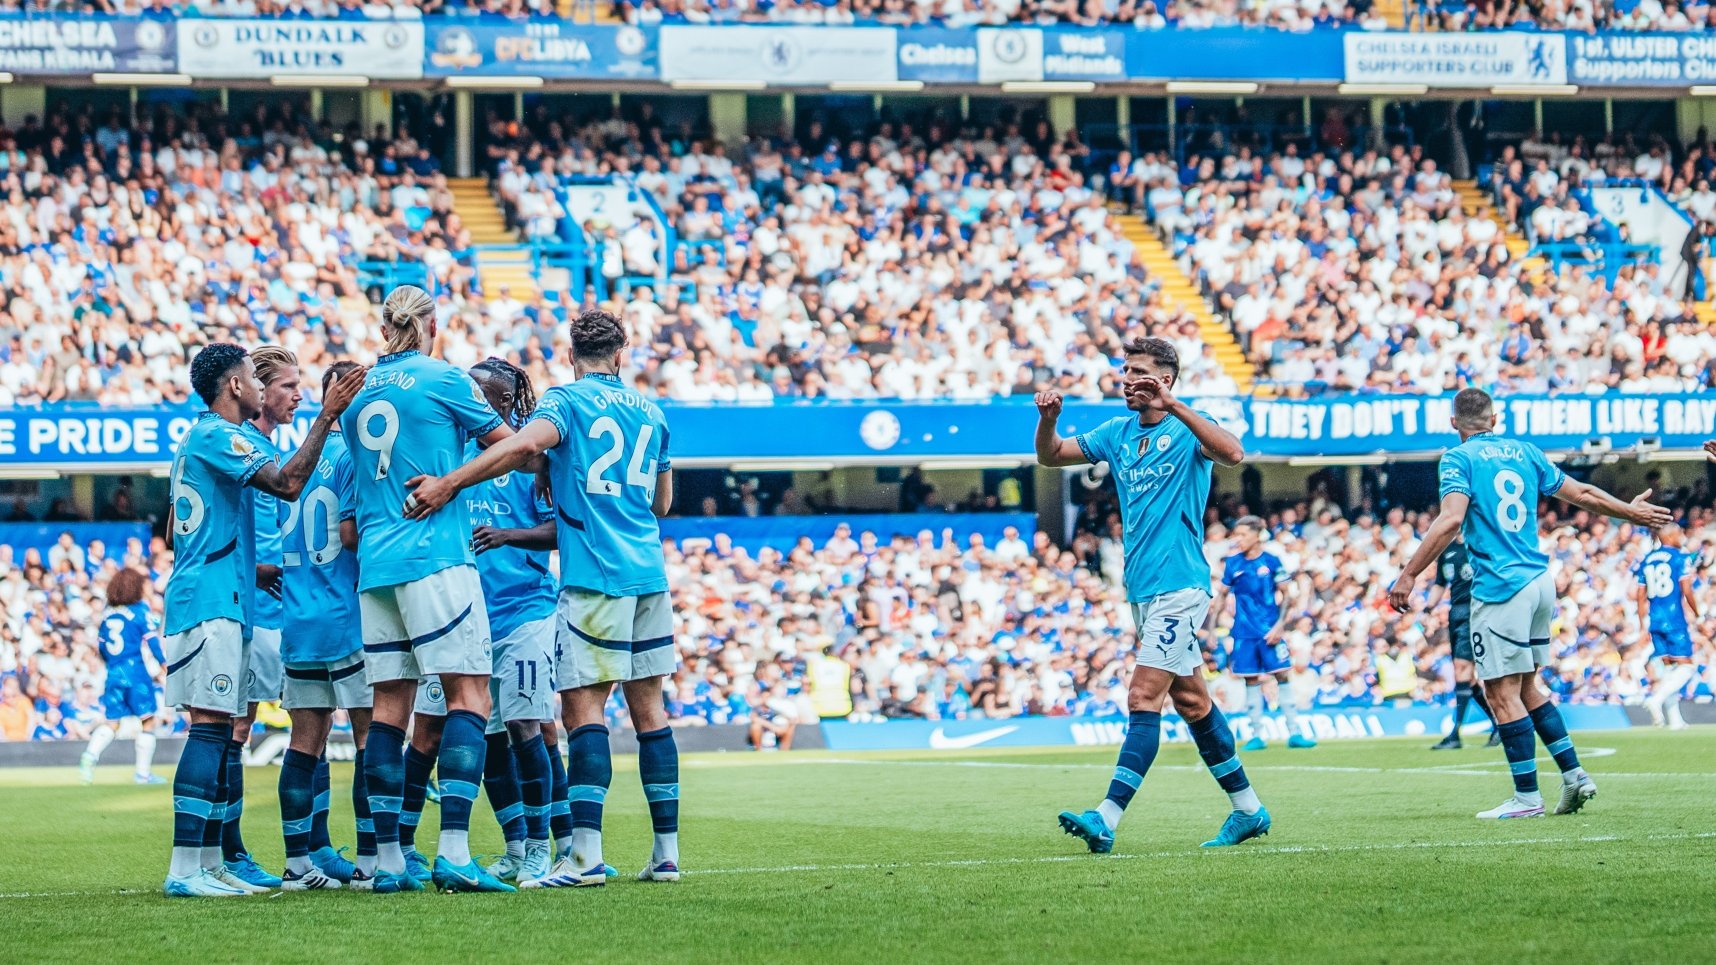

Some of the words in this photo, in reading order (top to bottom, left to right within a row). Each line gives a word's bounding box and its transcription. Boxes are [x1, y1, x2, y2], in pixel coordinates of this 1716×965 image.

[0, 20, 117, 47] CHELSEA
[234, 25, 368, 44] DUNDALK
[1059, 34, 1106, 54] West
[1610, 36, 1678, 58] ULSTER
[250, 47, 343, 67] BLUES
[900, 43, 976, 65] Chelsea
[1357, 41, 1430, 56] CHELSEA
[1436, 42, 1497, 57] ISRAELI
[1045, 54, 1122, 74] Midlands
[1357, 59, 1465, 73] SUPPORTERS
[1470, 60, 1514, 74] CLUB
[1573, 58, 1681, 82] Supporters
[591, 190, 606, 213] 2
[1611, 192, 1625, 215] 3
[1250, 401, 1327, 440] THEY
[1330, 399, 1420, 439] DON'T
[1510, 399, 1592, 436] THEM
[1596, 398, 1660, 435] LIKE
[28, 418, 160, 455] PRIDE
[356, 399, 400, 481] 9
[586, 416, 657, 502] 24
[1493, 469, 1527, 533] 8
[280, 484, 343, 566] 20
[1643, 562, 1675, 599] 18
[105, 618, 125, 656] 3
[1159, 617, 1180, 645] 3
[1472, 631, 1486, 658] 8
[515, 660, 537, 691] 11
